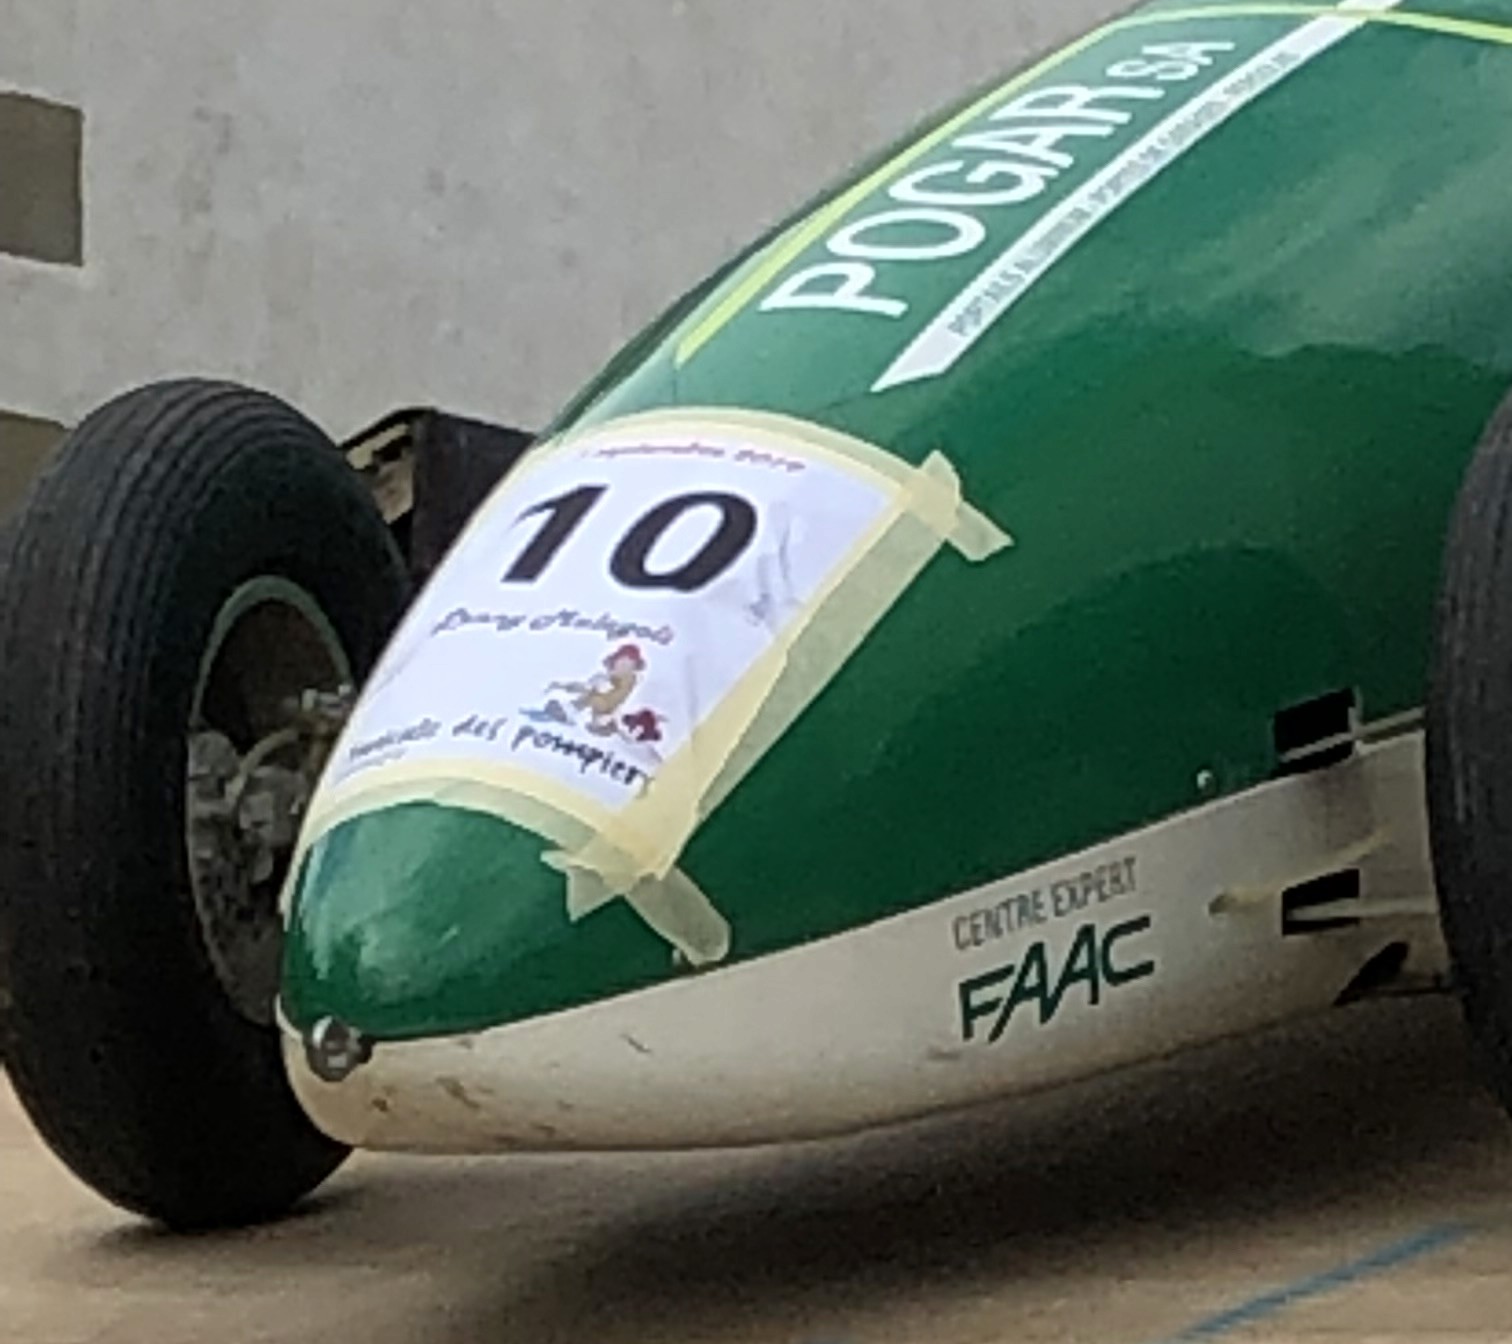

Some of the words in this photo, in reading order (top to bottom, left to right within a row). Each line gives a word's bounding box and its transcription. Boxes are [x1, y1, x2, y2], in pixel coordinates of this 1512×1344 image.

[759, 85, 1165, 317] POGAR
[1106, 41, 1235, 81] SA
[500, 483, 758, 594] 10
[954, 889, 1048, 950] CENTRE
[1052, 857, 1138, 918] EXPERT
[958, 913, 1155, 1044] FAAC
